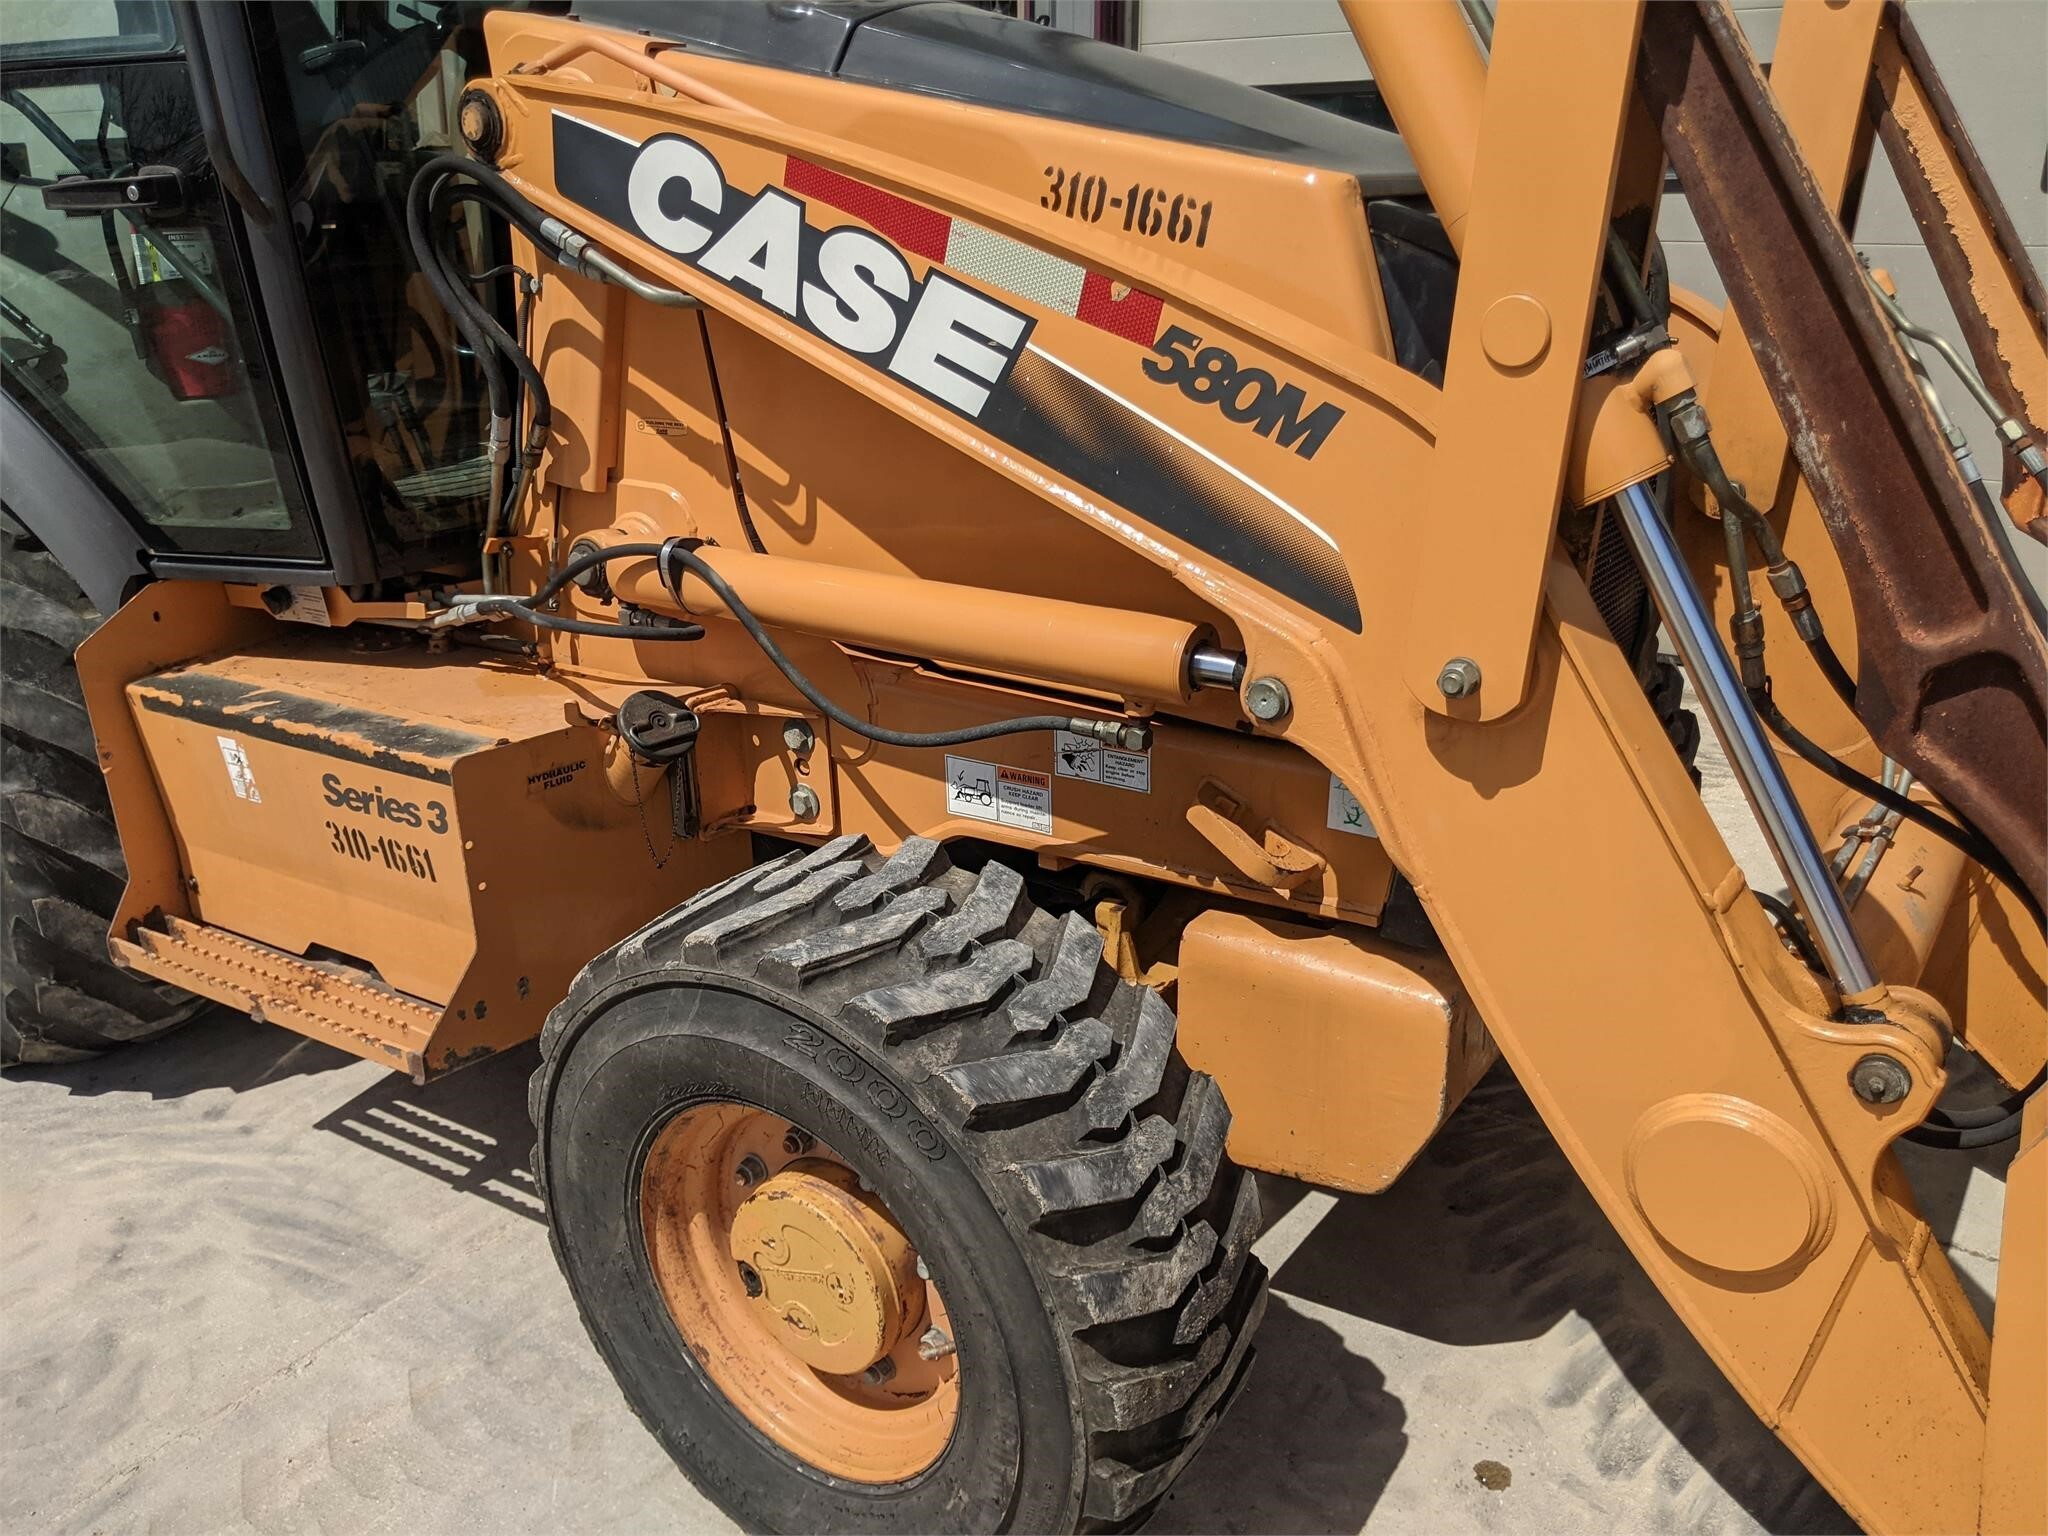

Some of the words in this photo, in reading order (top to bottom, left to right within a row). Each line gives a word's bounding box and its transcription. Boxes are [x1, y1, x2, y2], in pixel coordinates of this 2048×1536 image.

[1040, 165, 1213, 249] 310-1661
[627, 138, 1028, 418] CASE
[1141, 323, 1346, 461] 580M
[527, 760, 587, 785] HYDRAULIC
[1009, 771, 1046, 786] WARNING
[1107, 753, 1145, 764] ENTANGLEMENT
[322, 773, 422, 828] Series
[426, 800, 449, 834] 3
[543, 774, 574, 790] FLUID
[1003, 785, 1022, 793] CRUSH
[1022, 789, 1044, 798] HAZARD
[325, 820, 437, 883] 310-1661
